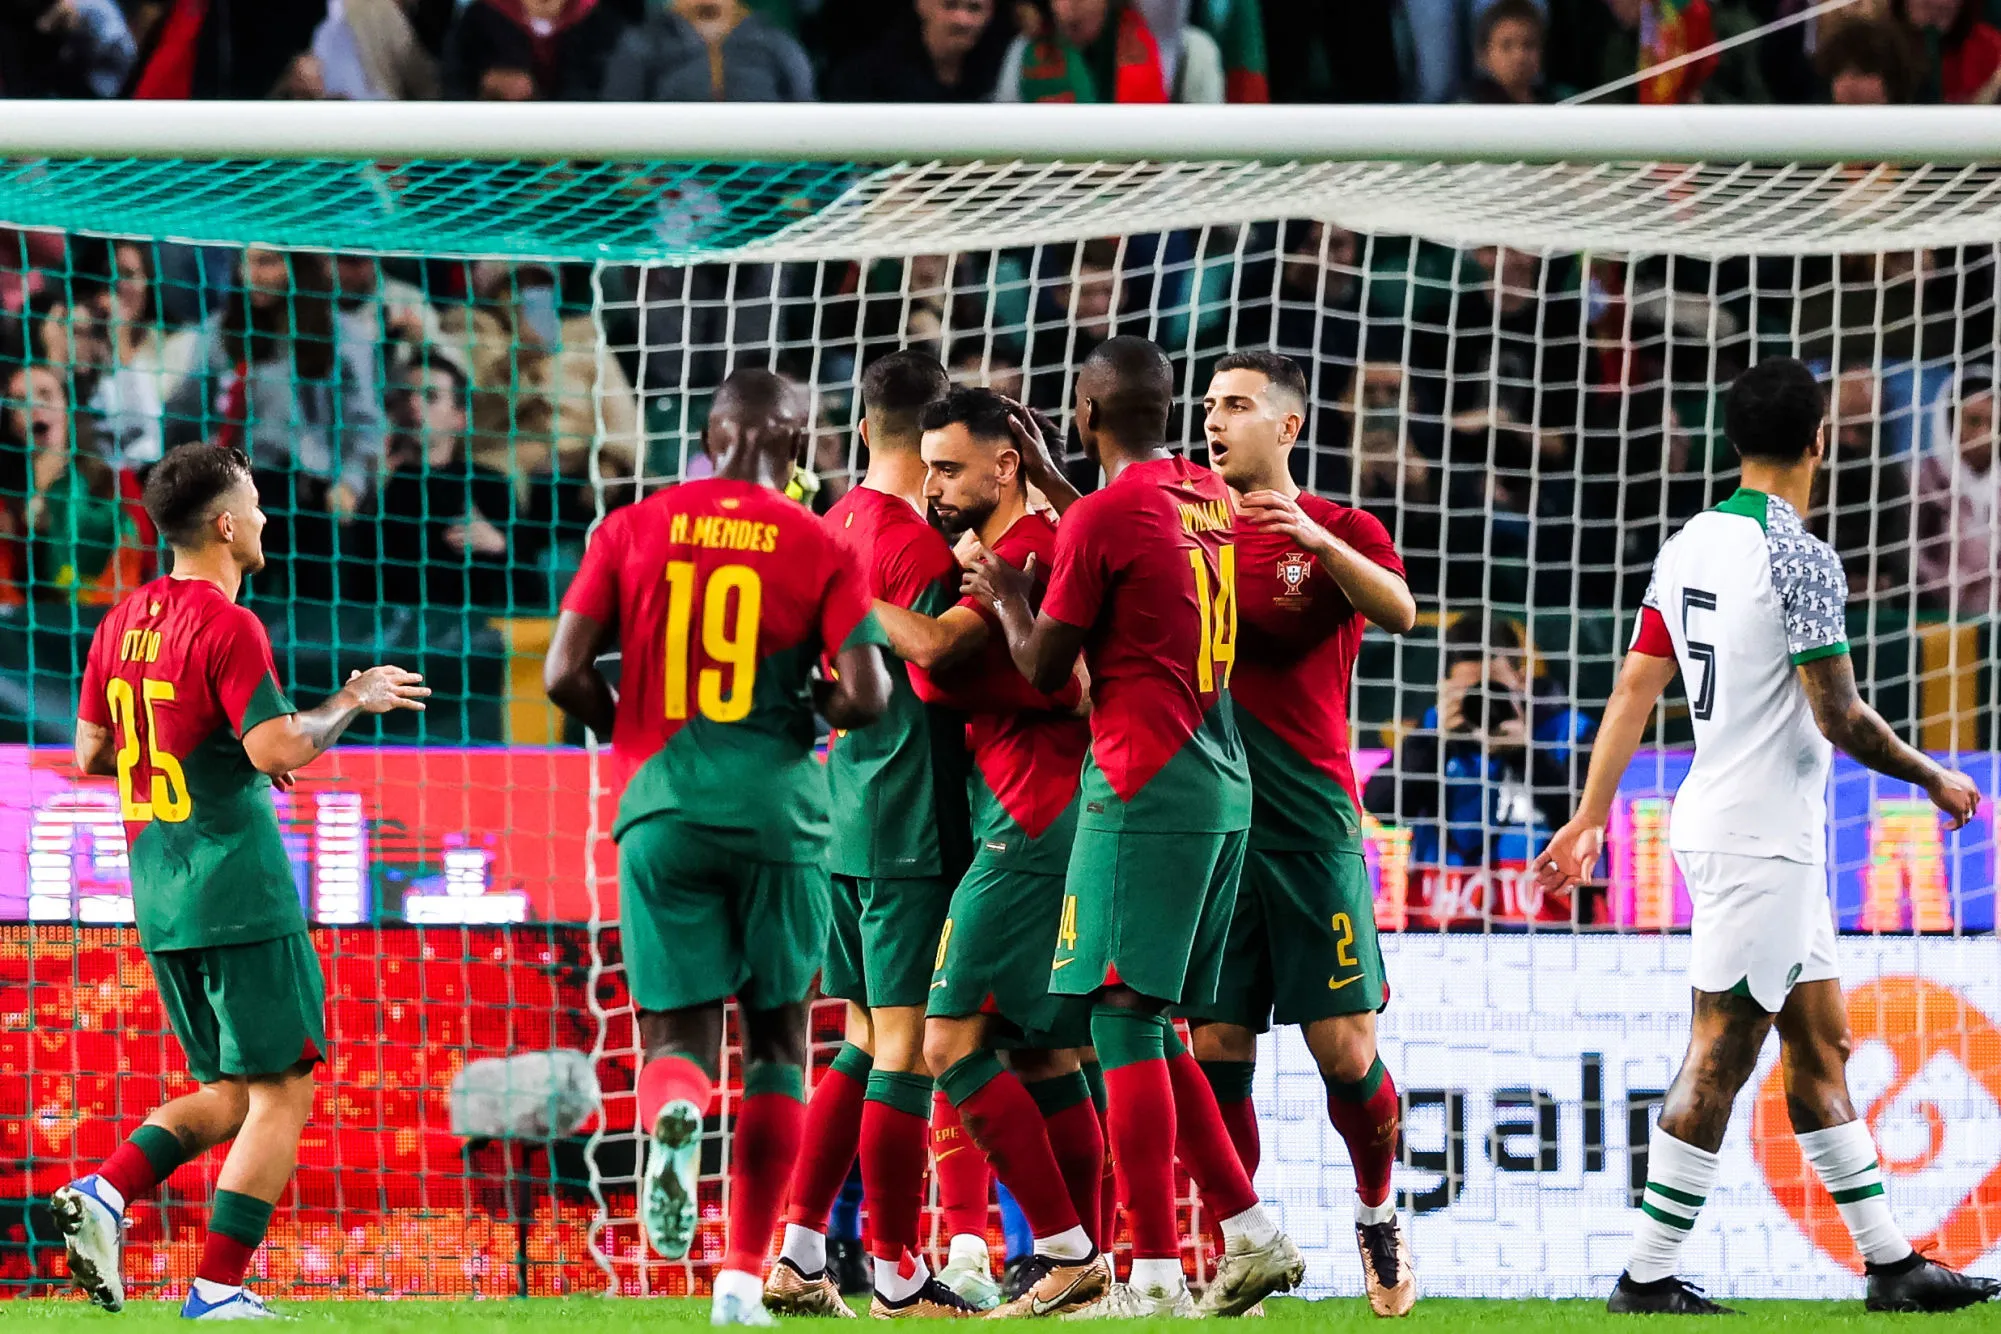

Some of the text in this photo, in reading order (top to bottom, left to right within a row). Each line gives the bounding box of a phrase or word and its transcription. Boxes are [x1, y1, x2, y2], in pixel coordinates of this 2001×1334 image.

[670, 512, 779, 553] N.MENDES
[1177, 498, 1231, 533] WILLIAM
[121, 627, 161, 662] OTÁIO
[665, 560, 762, 722] 19
[1189, 544, 1237, 692] 14
[1683, 587, 1717, 721] 5
[107, 677, 191, 822] 25
[1332, 912, 1358, 966] 2
